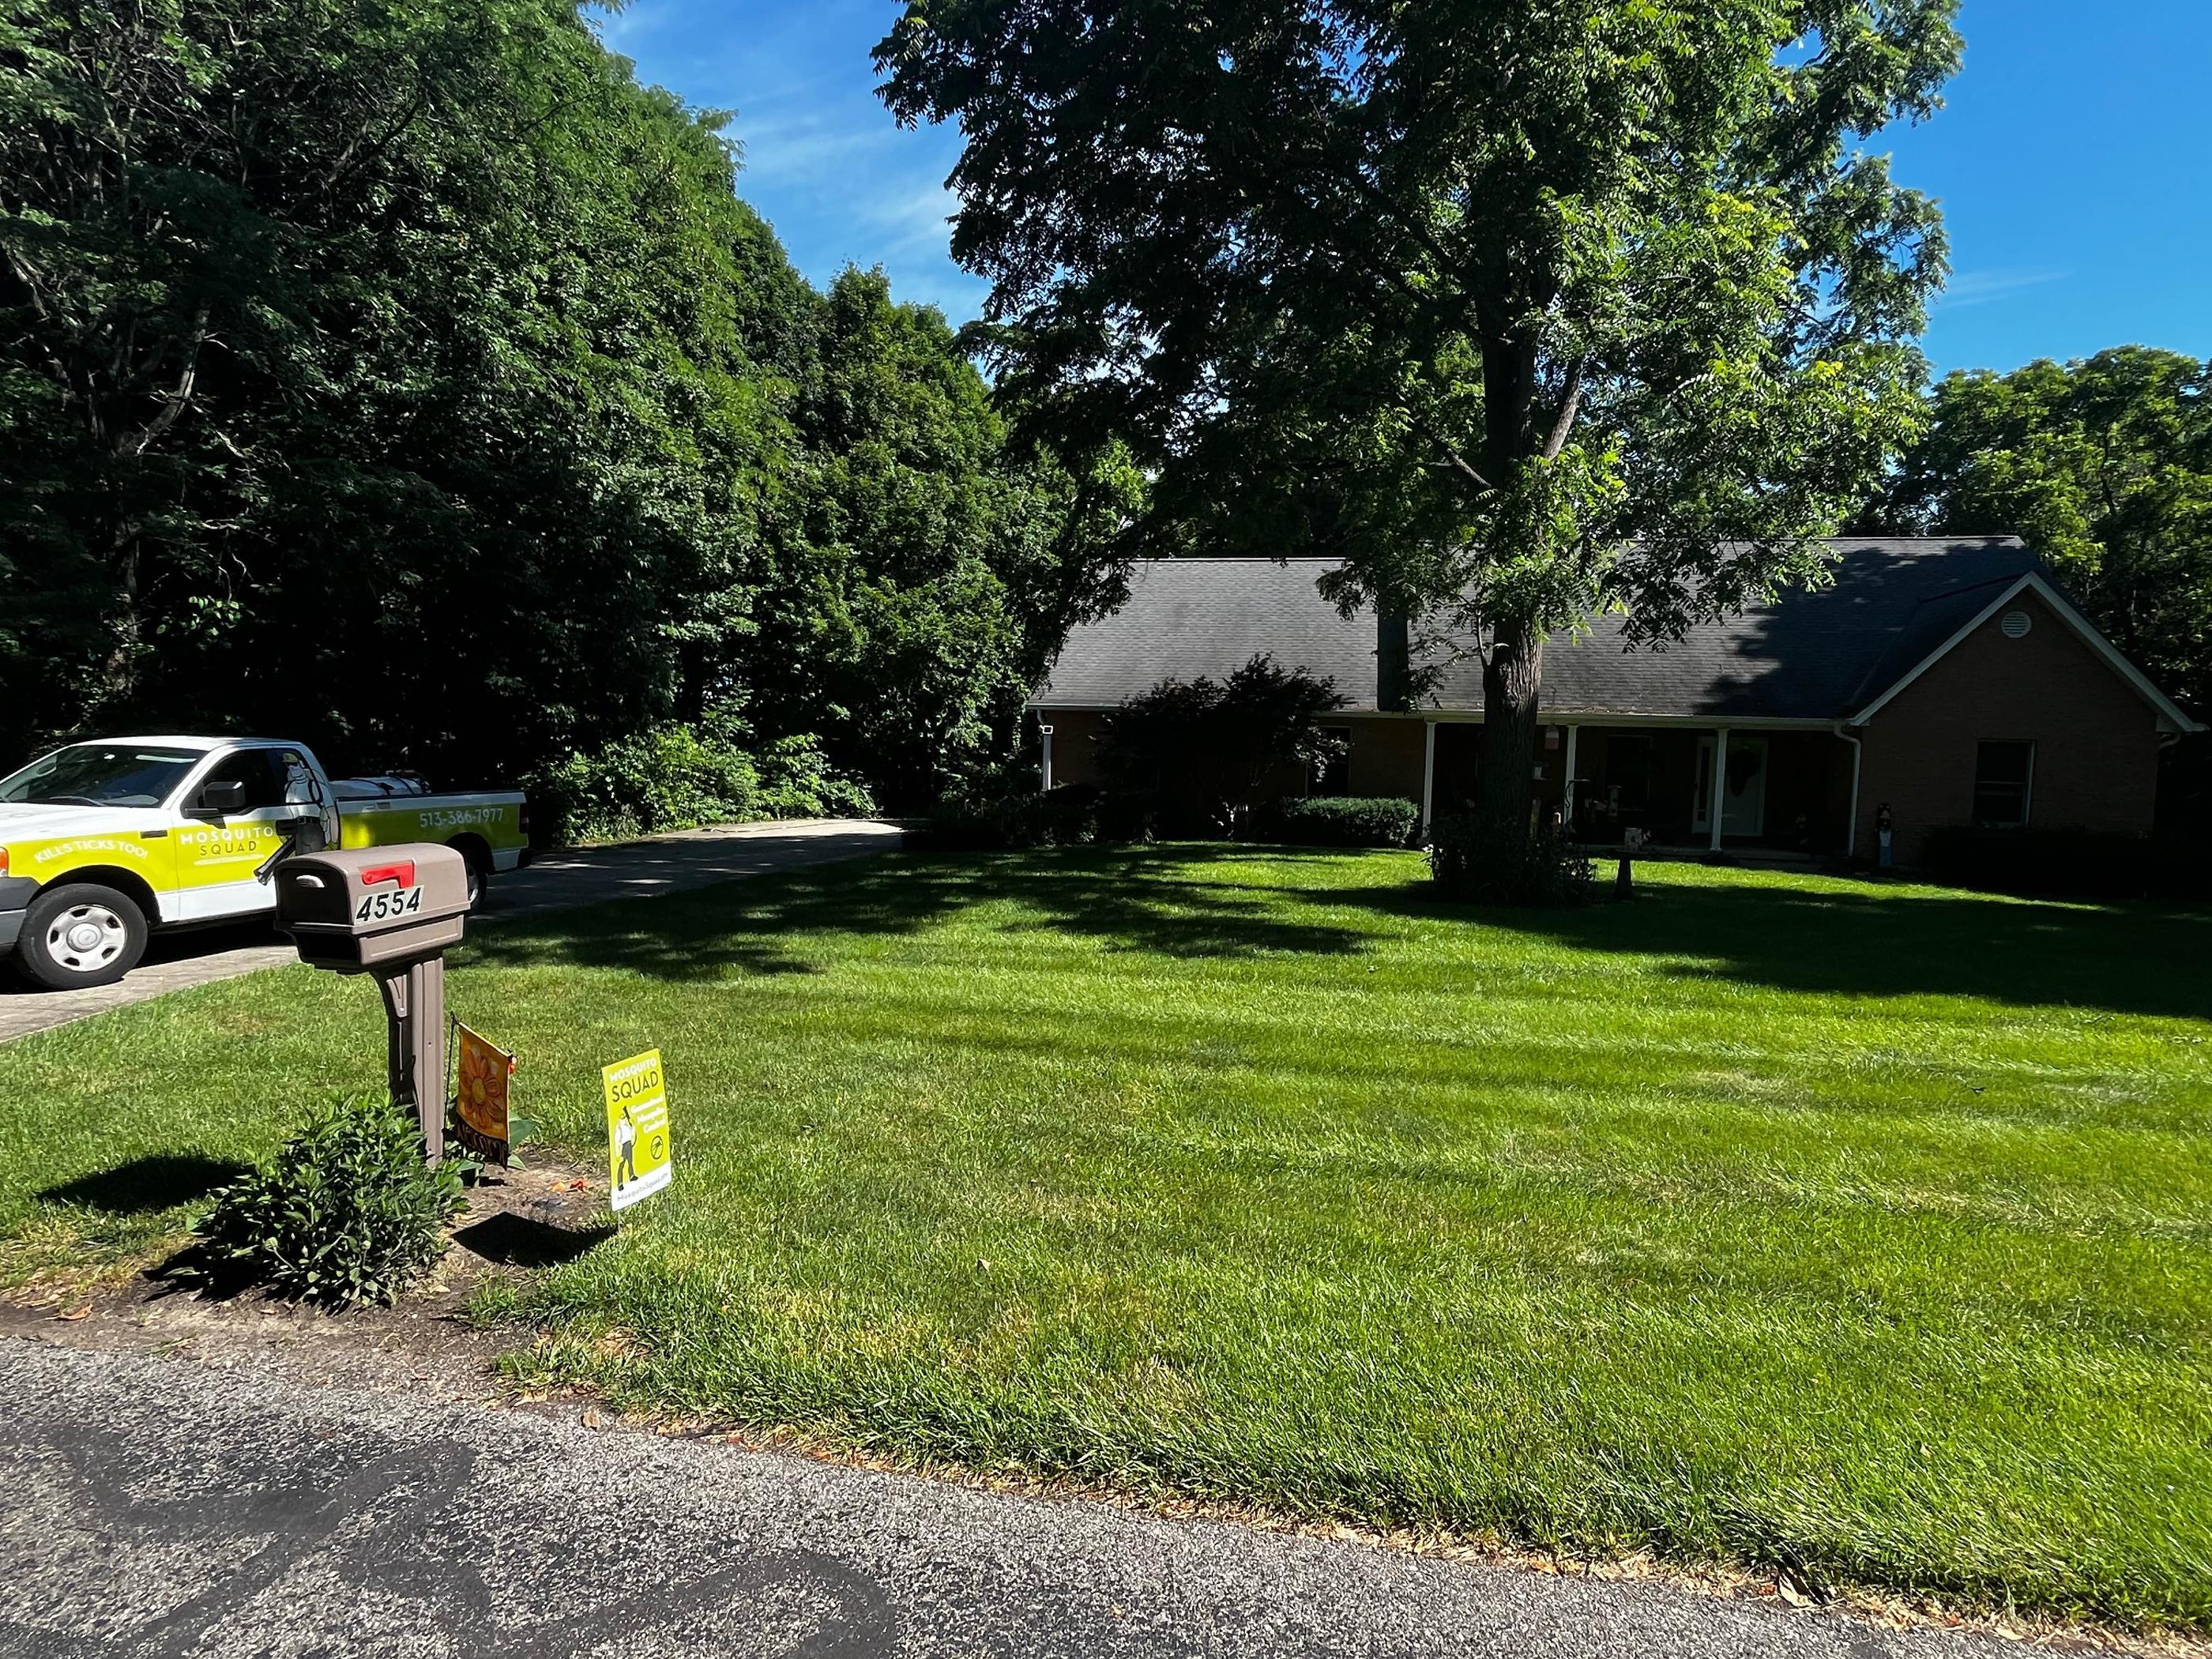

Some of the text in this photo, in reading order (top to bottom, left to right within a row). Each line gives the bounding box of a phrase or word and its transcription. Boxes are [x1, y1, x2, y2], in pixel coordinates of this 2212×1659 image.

[419, 807, 504, 828] 513-386-7977
[180, 826, 273, 845] MOSQUITO
[34, 840, 149, 863] KILLS TICKS TOO!
[199, 841, 257, 856] SQUAD
[356, 887, 421, 921] 4554
[609, 1057, 658, 1083] MOSQUITO
[611, 1070, 659, 1102] SQUAD
